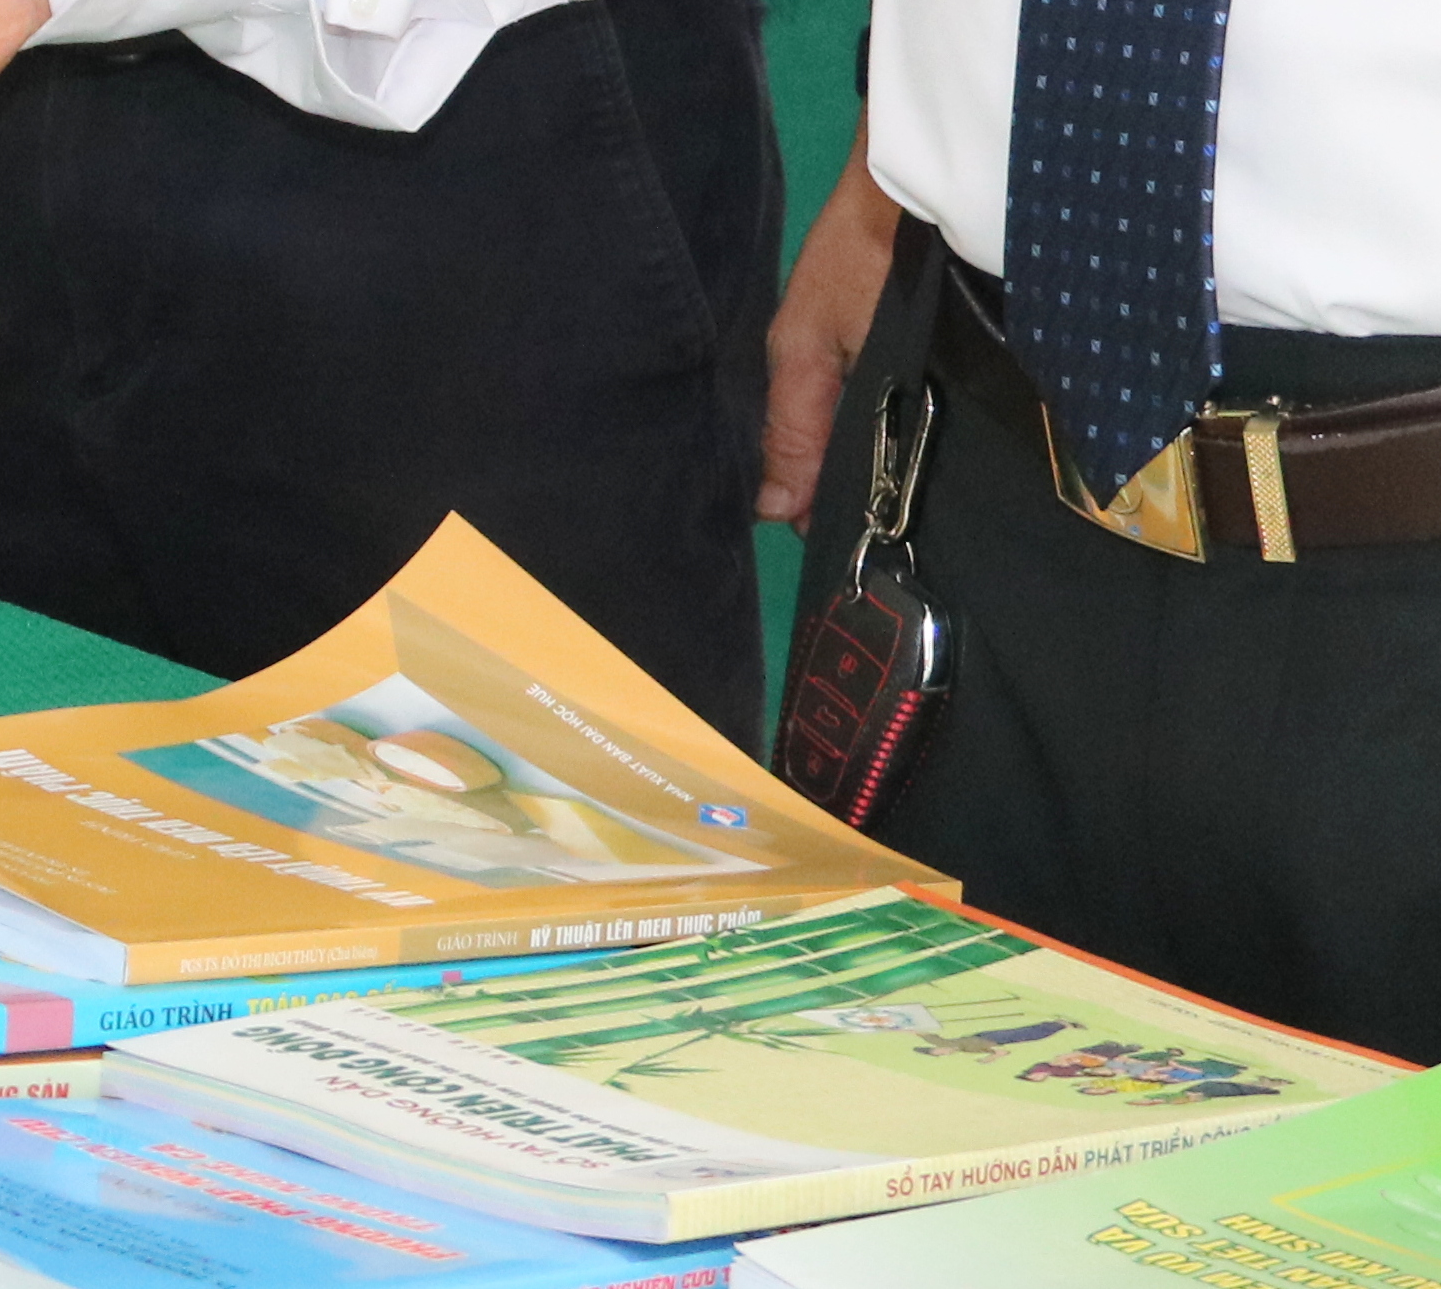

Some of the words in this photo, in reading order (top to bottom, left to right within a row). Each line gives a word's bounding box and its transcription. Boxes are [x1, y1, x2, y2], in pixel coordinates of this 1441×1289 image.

[524, 682, 556, 709] HUẾ
[552, 704, 584, 729] HỌC
[578, 723, 606, 745] ĐẠI
[436, 931, 473, 953] GIÁO
[473, 928, 519, 949] TRÌNH
[529, 922, 554, 949] KỸ
[555, 919, 603, 949] THUẬT
[605, 916, 635, 943] LÊN
[636, 916, 673, 939] MEN
[98, 1002, 157, 1034] GIÁO
[160, 995, 235, 1028] TRÌNH
[24, 1080, 71, 1100] SẢN
[885, 1164, 915, 1199] SỔ
[918, 1170, 955, 1194] TAY
[961, 1158, 1032, 1189] HƯỚNG
[1037, 1145, 1079, 1177] DẪN
[1084, 1140, 1135, 1170] PHÁT
[1085, 1223, 1143, 1255] VÀ
[1213, 1212, 1323, 1253] SINH
[1308, 1249, 1399, 1279] KHI
